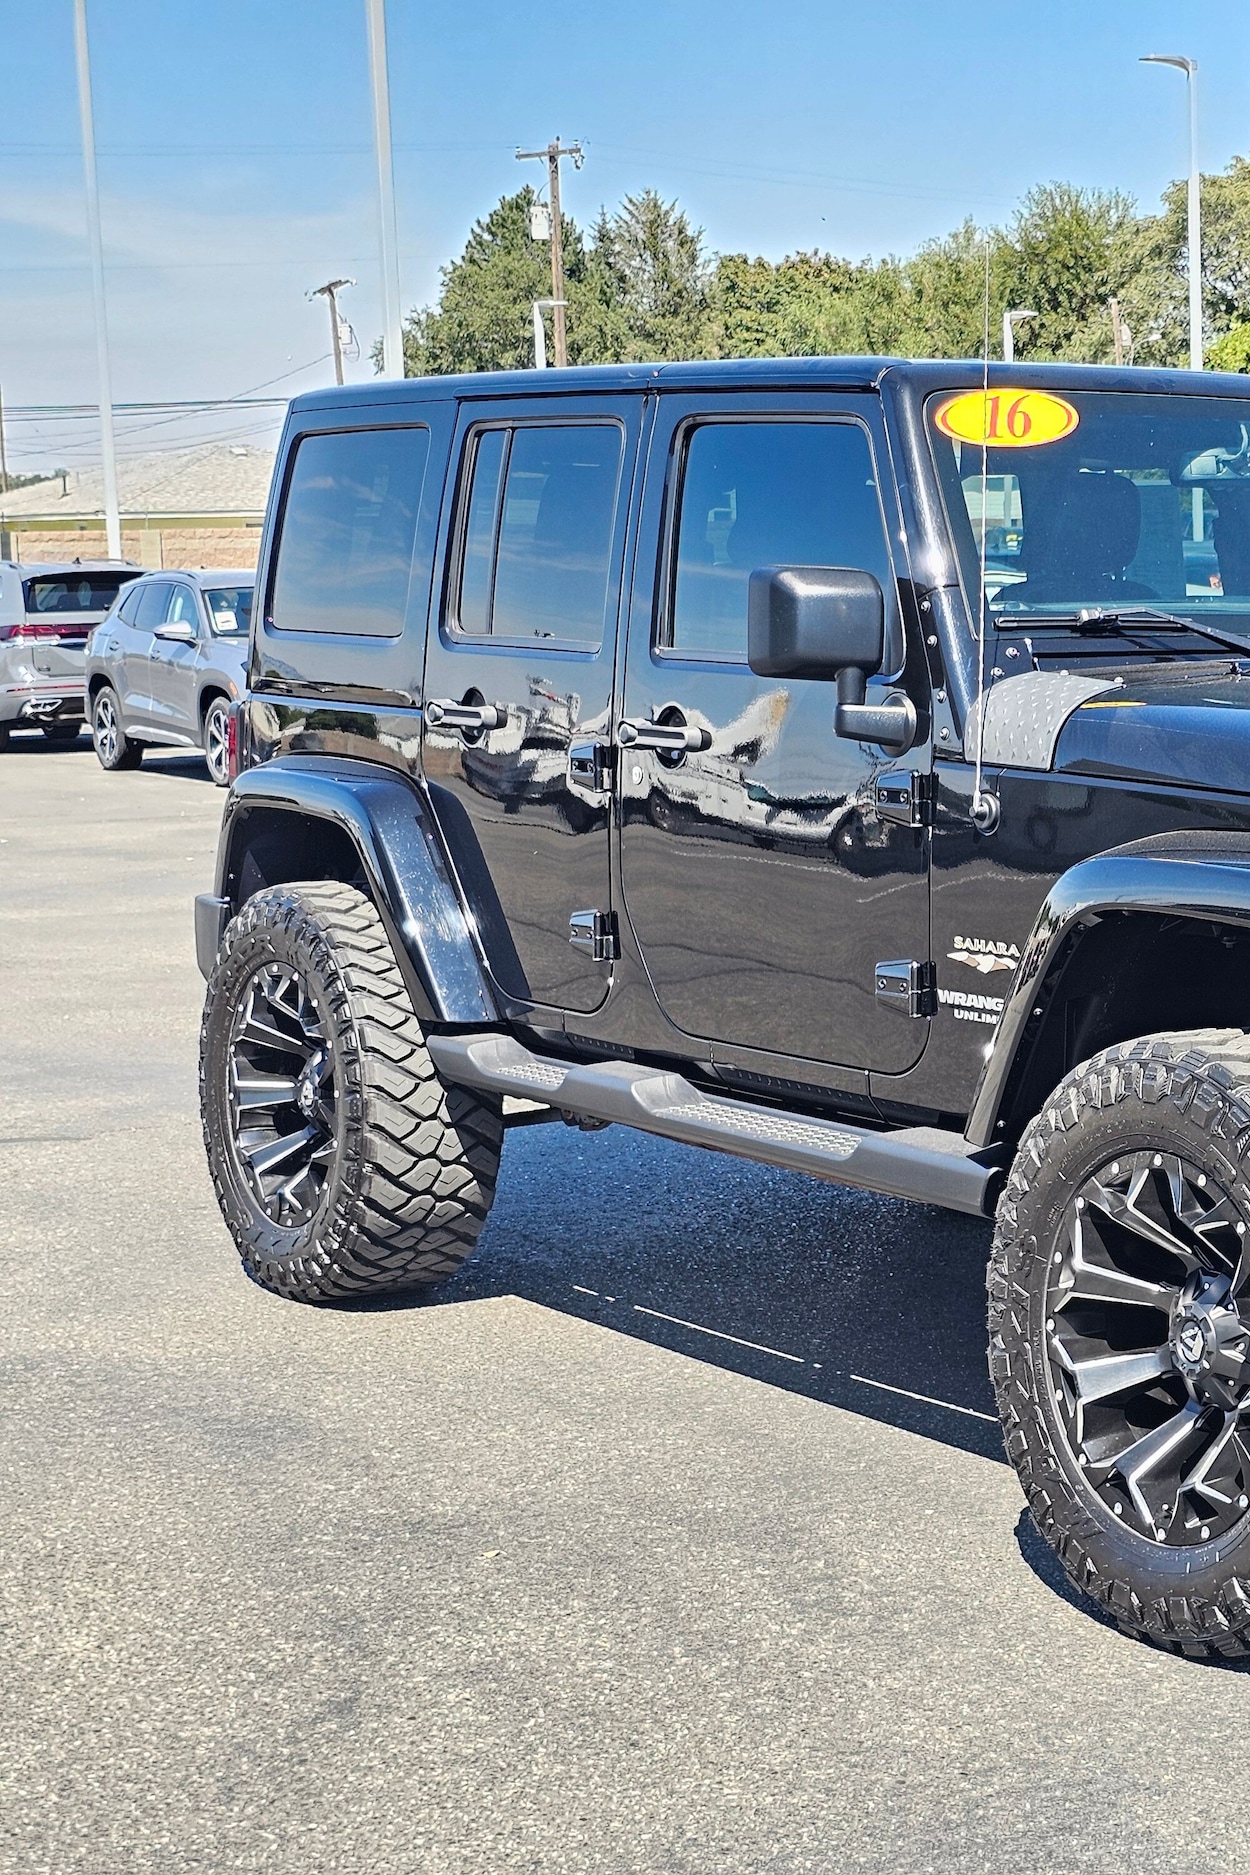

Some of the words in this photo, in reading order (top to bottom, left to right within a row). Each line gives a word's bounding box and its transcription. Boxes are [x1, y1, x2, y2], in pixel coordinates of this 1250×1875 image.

[985, 394, 1032, 439] 16
[953, 935, 1021, 958] SAHARA
[953, 1008, 1001, 1025] UNLIM
